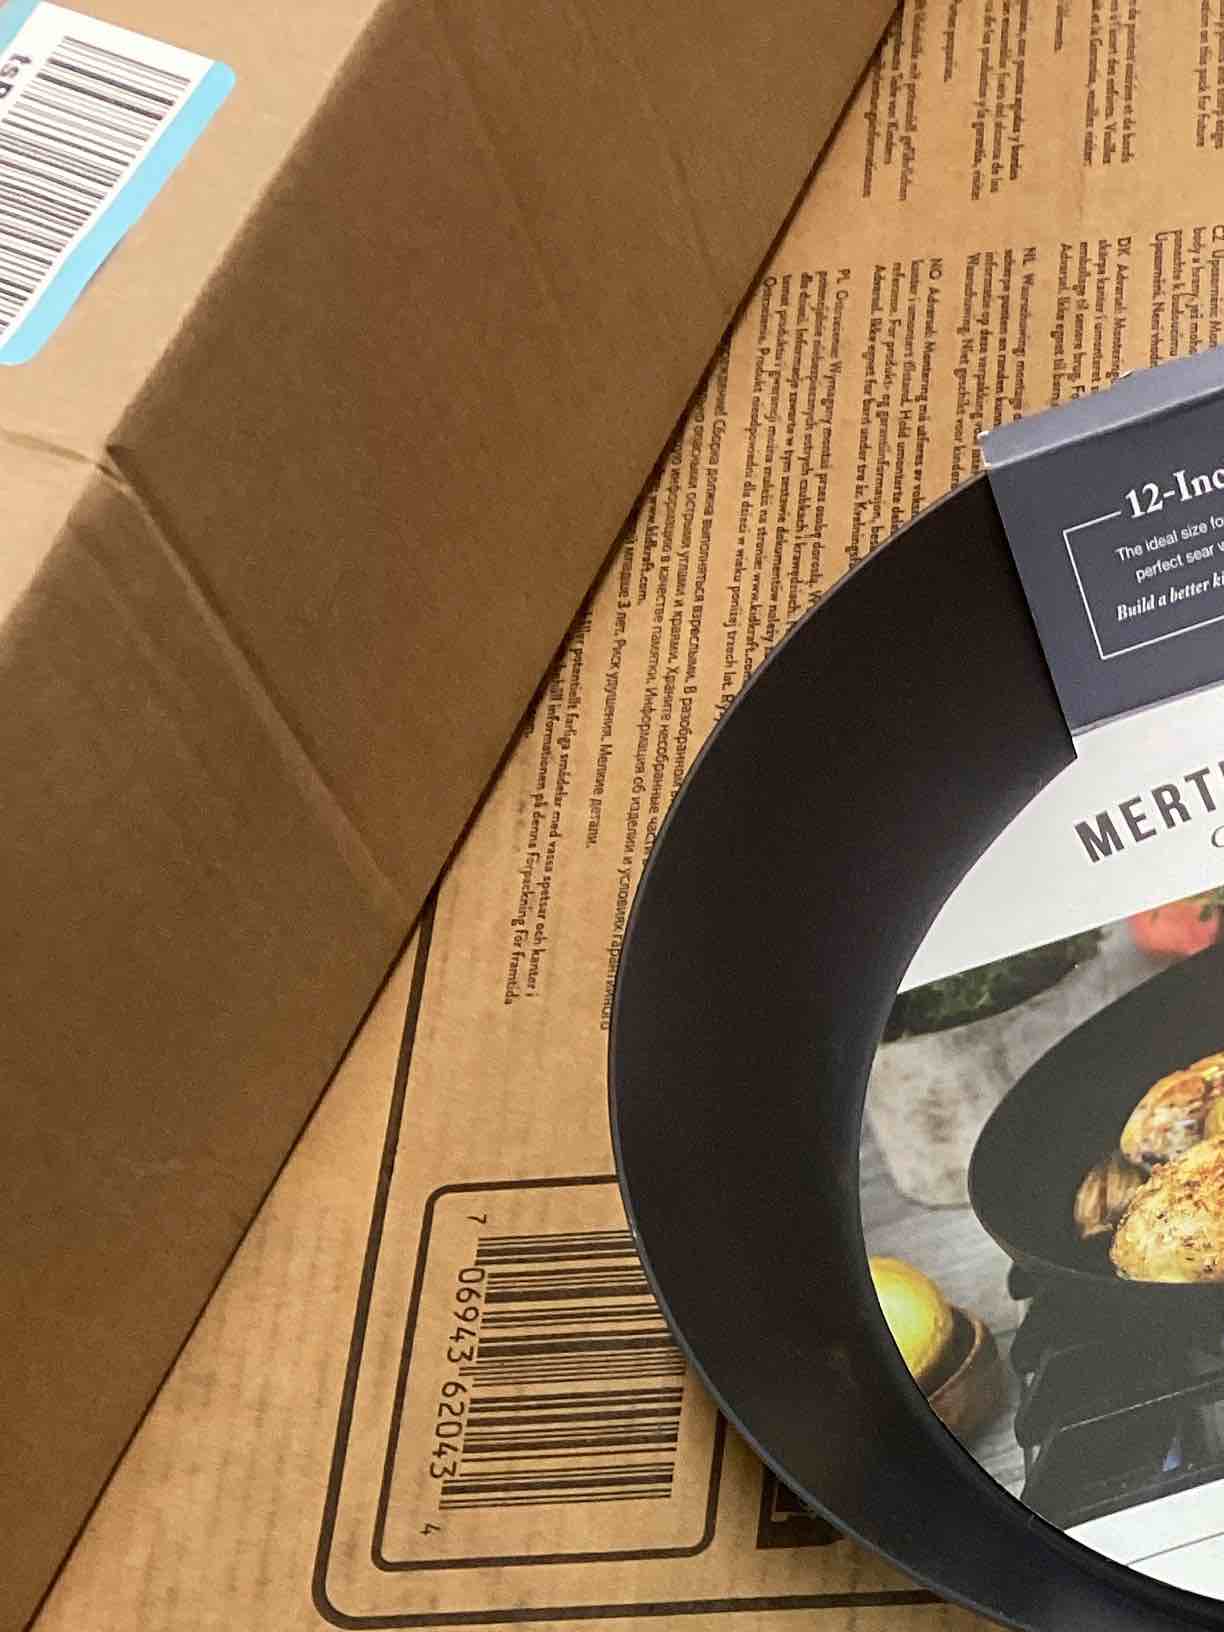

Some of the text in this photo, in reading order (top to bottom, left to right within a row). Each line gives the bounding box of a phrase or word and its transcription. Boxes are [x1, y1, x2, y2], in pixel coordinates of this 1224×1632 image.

[1115, 545, 1143, 561] The
[1145, 529, 1178, 552] ideal
[1181, 522, 1208, 540] size
[1135, 554, 1184, 584] perfect
[1185, 544, 1214, 563] sear
[1117, 594, 1155, 621] Build
[1158, 594, 1167, 607] a
[1170, 580, 1210, 603] better
[546, 809, 563, 839] med
[531, 921, 547, 946] och
[420, 1214, 487, 1536] 7 06943 62043 4
